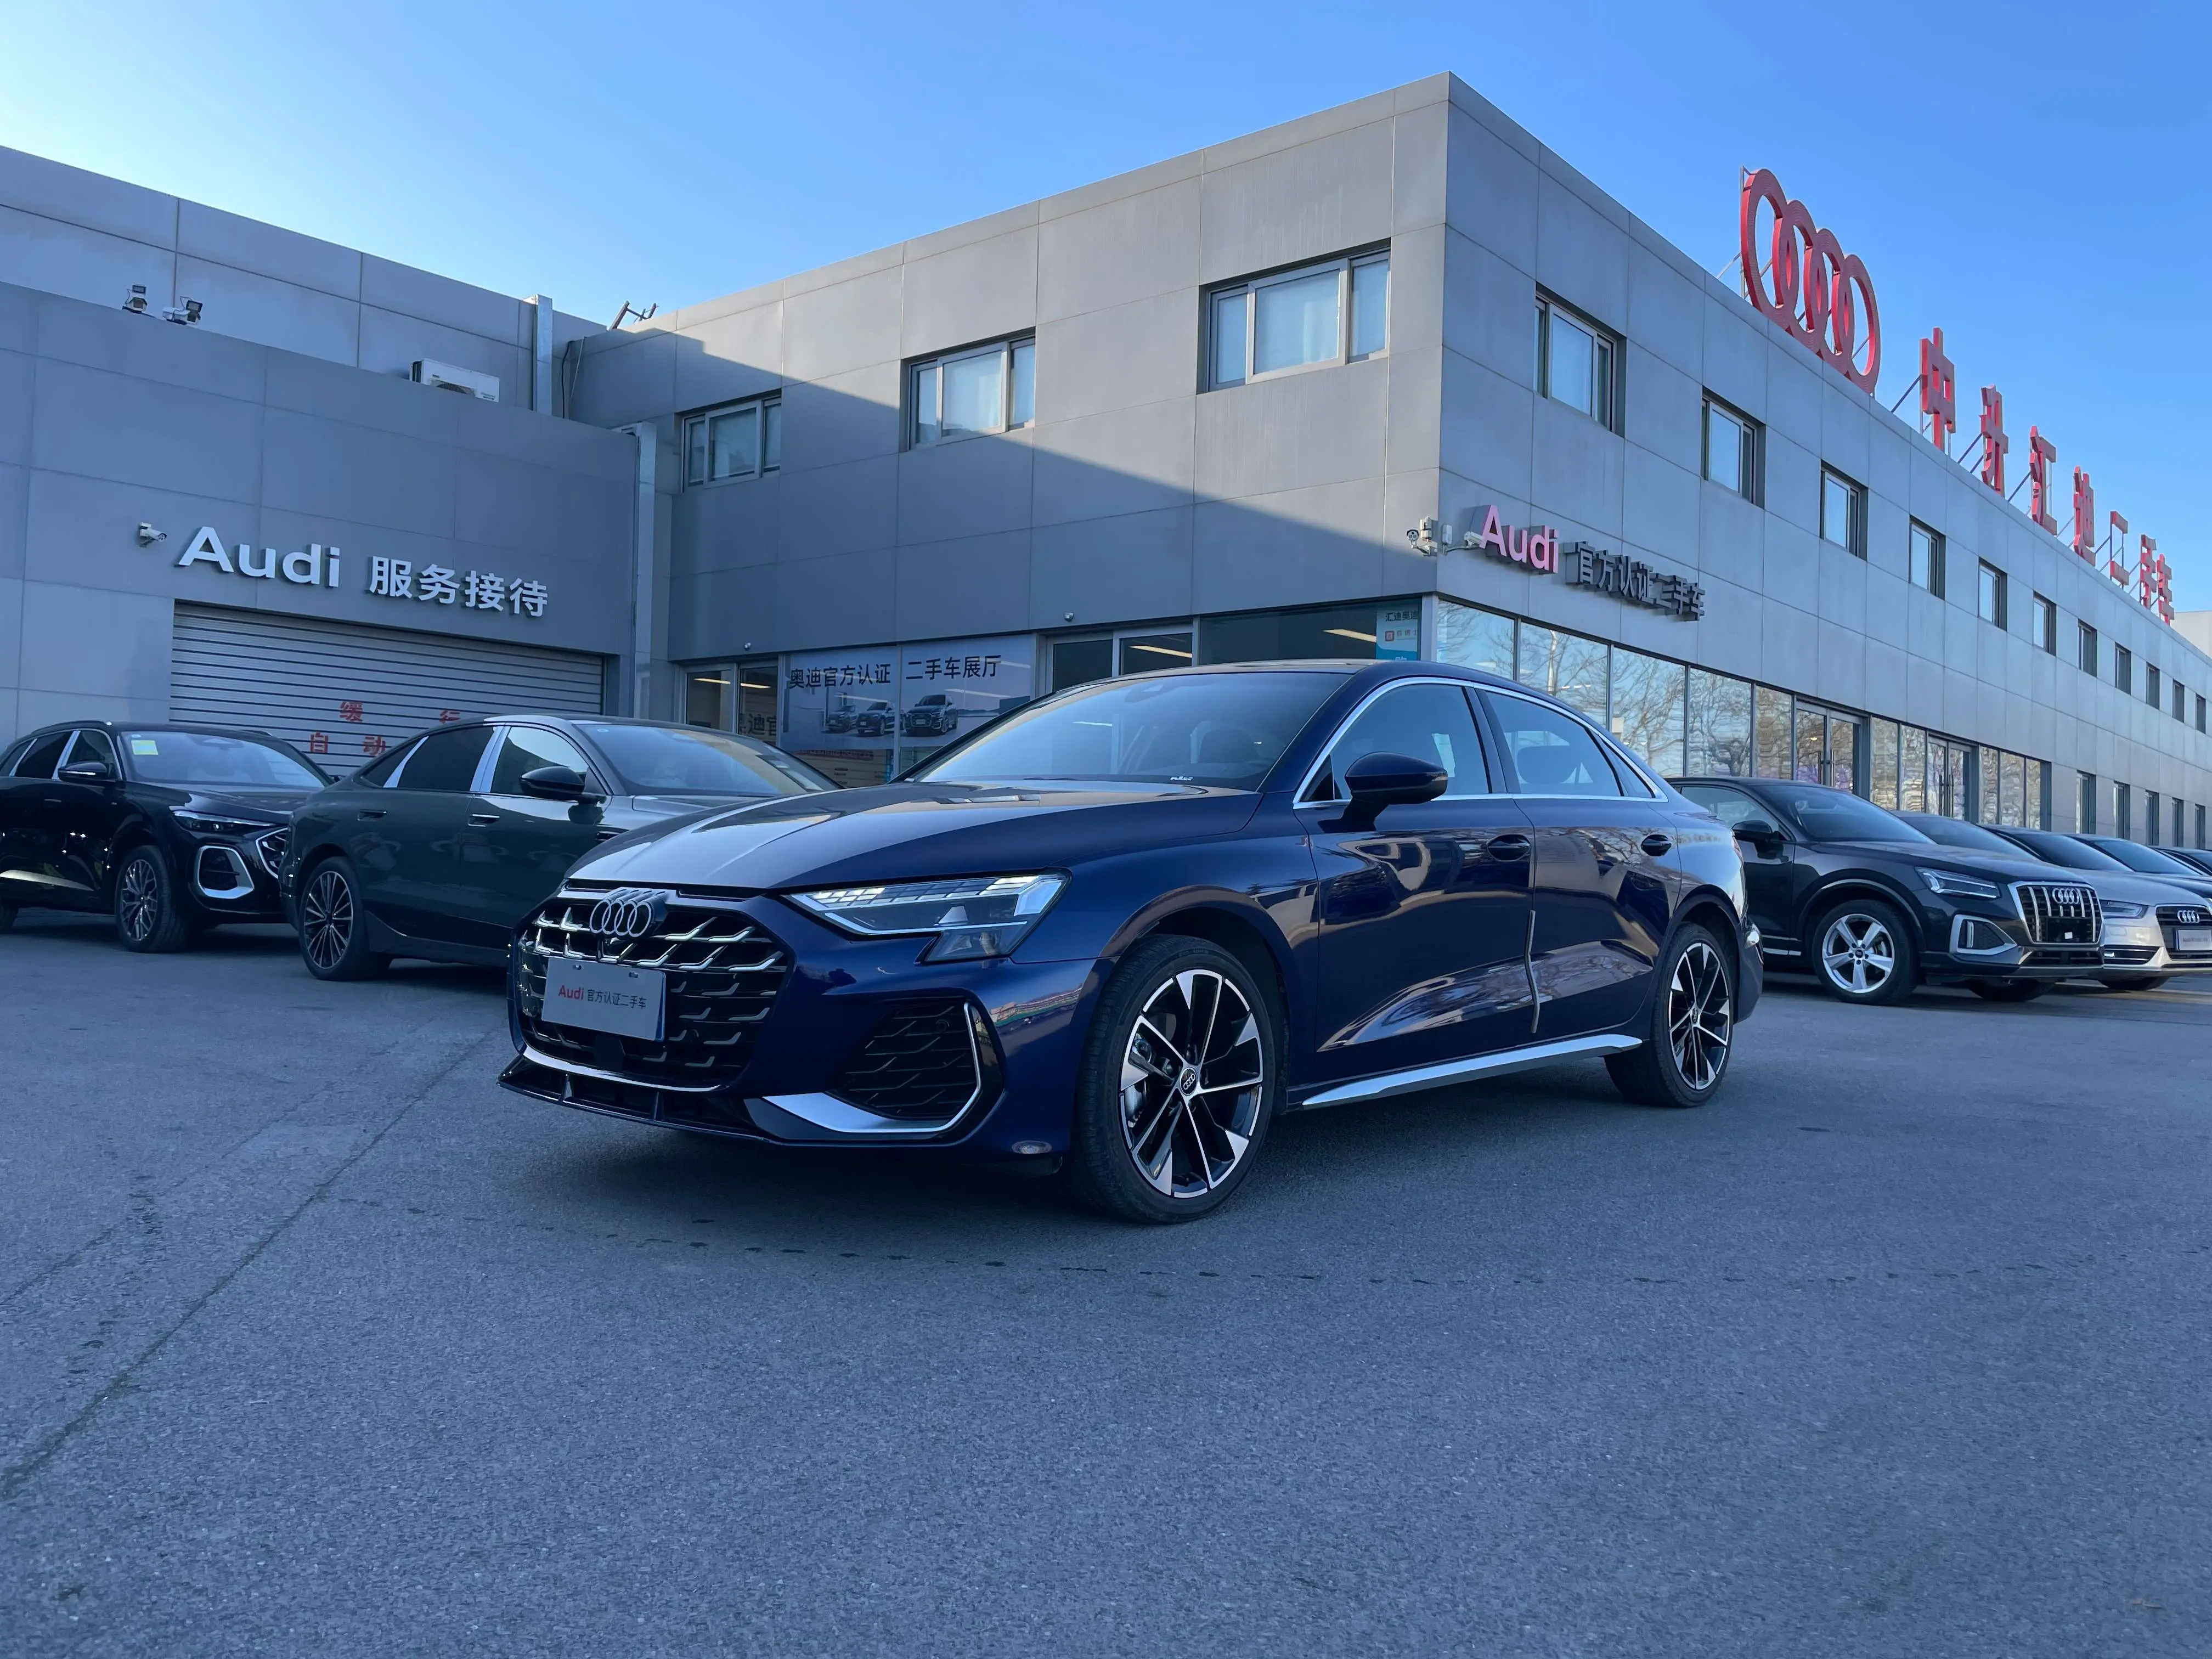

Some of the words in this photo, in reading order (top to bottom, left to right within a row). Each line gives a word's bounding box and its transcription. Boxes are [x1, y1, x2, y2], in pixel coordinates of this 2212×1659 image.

[178, 526, 341, 588] Audi
[369, 555, 548, 618] 服务接待
[1481, 505, 1559, 574] Audi
[1572, 541, 1705, 621] 官方认证二手车
[789, 663, 891, 690] 奥迪官方认证
[906, 655, 1001, 680] 二手车展厅
[558, 985, 584, 1000] Audi
[587, 989, 647, 1009] 官方认证二手车
